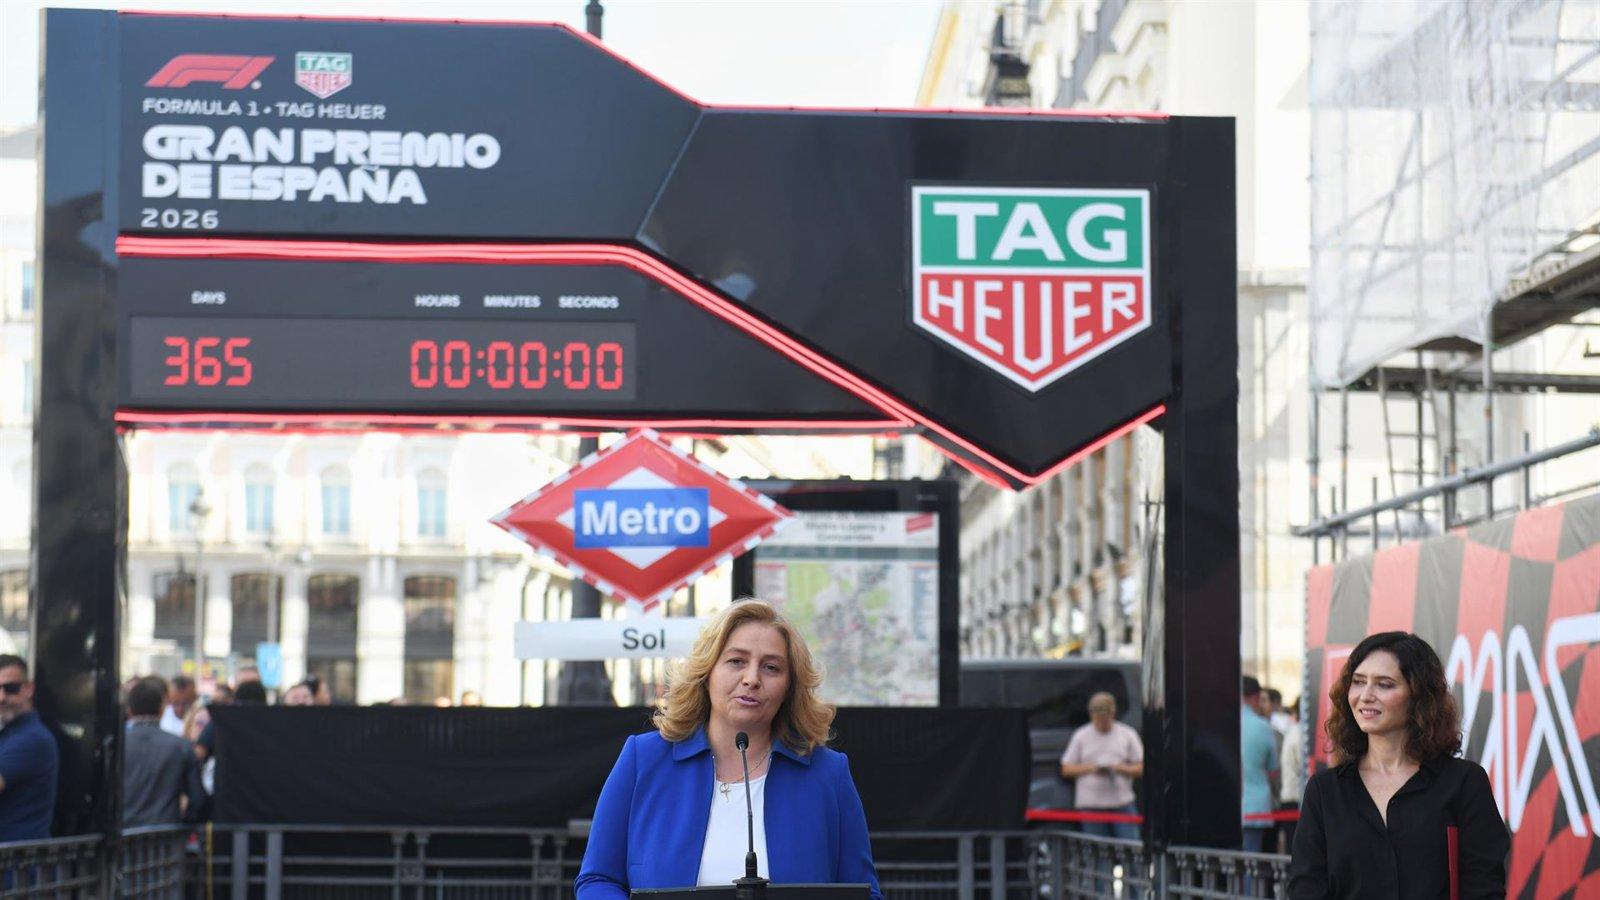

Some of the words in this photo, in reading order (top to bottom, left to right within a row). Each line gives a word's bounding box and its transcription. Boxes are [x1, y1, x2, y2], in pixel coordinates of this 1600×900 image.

[304, 55, 348, 72] TAG
[142, 98, 242, 116] FORMULA
[247, 101, 260, 116] 1
[275, 102, 316, 118] TAG
[318, 103, 387, 120] HEUER
[142, 125, 295, 164] GRAN
[300, 129, 502, 170] PREMIO
[142, 162, 213, 199] DE
[218, 164, 428, 205] ESPAÑA
[141, 208, 220, 229] 2026
[933, 201, 1128, 263] TAG
[191, 291, 226, 304] DAYS
[415, 295, 461, 308] HOURS
[484, 295, 541, 308] MINUTES
[558, 296, 620, 309] SECONDS
[927, 279, 1137, 374] HEUER
[164, 336, 252, 386] 365
[411, 340, 623, 390] 00:00:00
[582, 500, 701, 536] Metro
[622, 628, 666, 650] Sol
